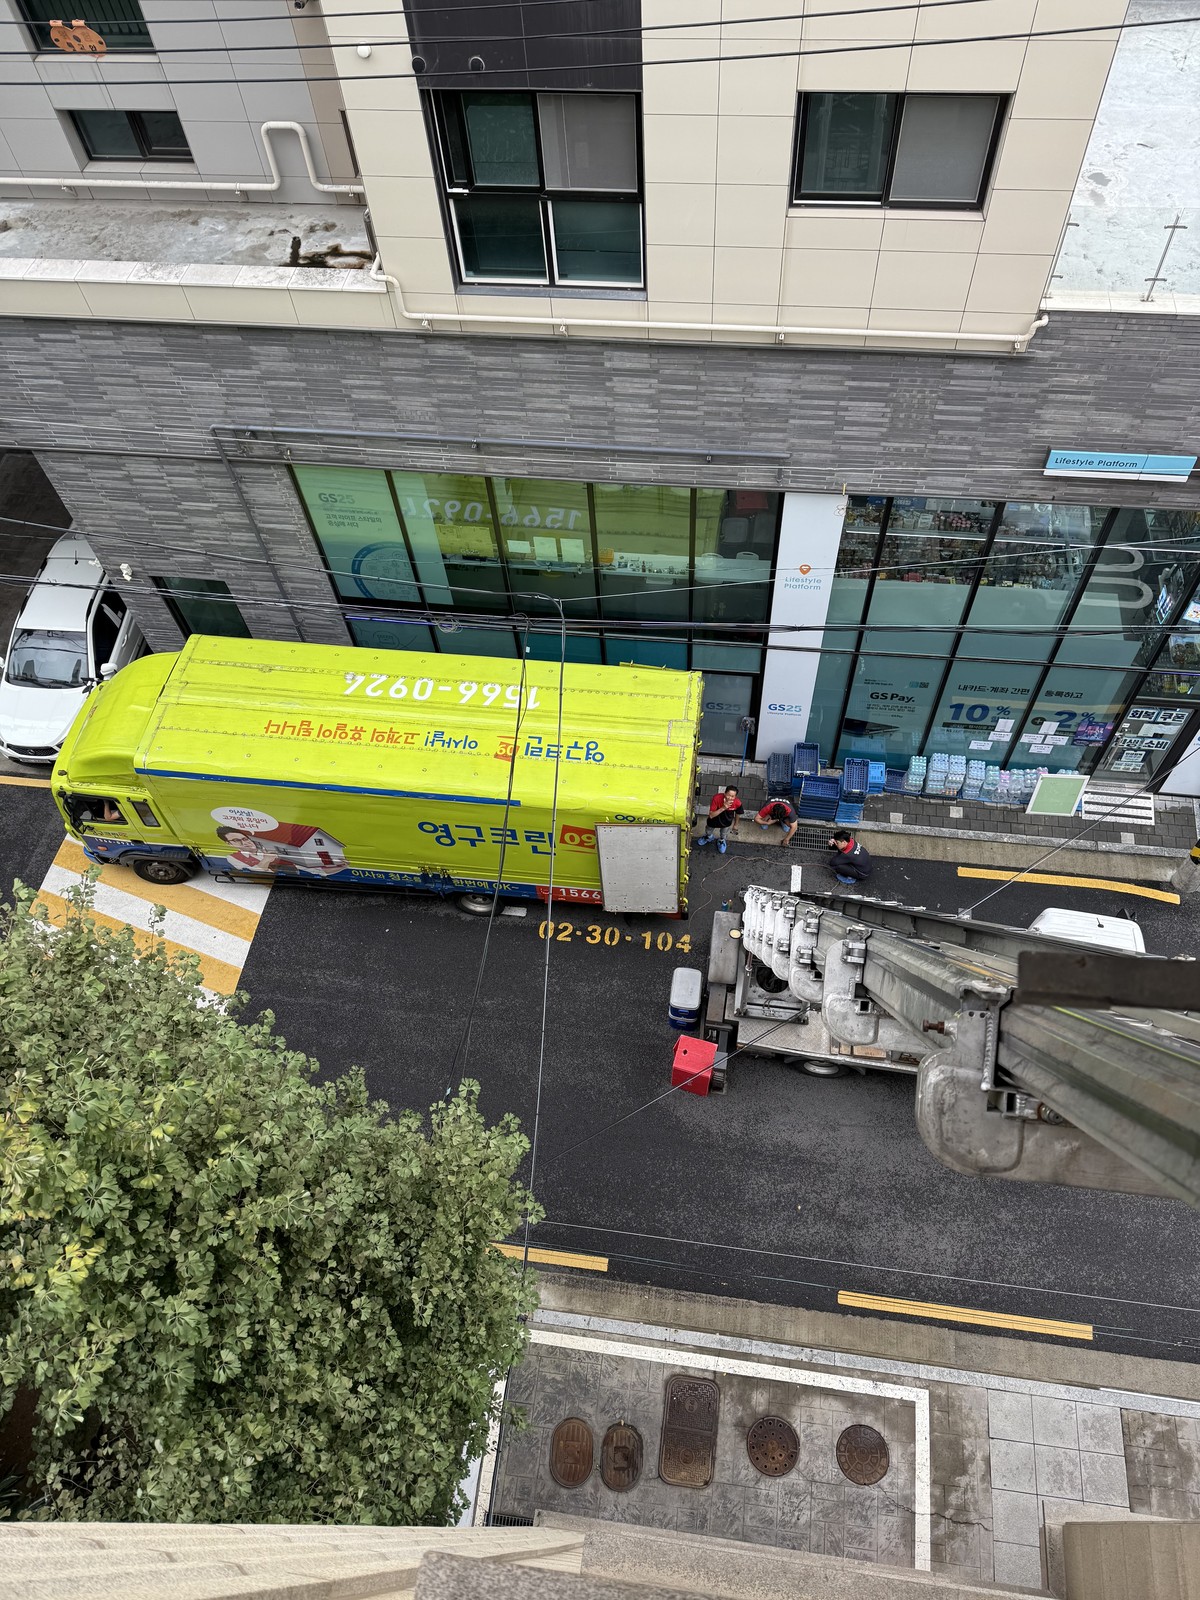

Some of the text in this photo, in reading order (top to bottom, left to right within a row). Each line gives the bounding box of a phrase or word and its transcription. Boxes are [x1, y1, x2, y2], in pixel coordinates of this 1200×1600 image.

[1055, 457, 1138, 468] Lifestyle Platform
[318, 492, 355, 504] GS25
[784, 576, 822, 585] Lifestyle
[783, 583, 821, 591] Platform
[344, 673, 541, 710] 1566-0924
[1010, 687, 1030, 695] 간편
[1044, 690, 1083, 699] 등록하고
[869, 692, 915, 704] GS Pay.
[705, 702, 741, 712] GS25
[767, 703, 802, 713] GS25
[1129, 709, 1186, 723] 회복 쿠폰
[264, 719, 314, 738] 됩니다
[317, 723, 367, 743] 휴일이
[370, 726, 420, 745] 고객의
[424, 730, 479, 751] 이사날!
[524, 735, 605, 763] 영구크린
[1143, 740, 1168, 750] 소비
[417, 821, 557, 856] 영구크린
[351, 869, 385, 879] 이사와
[452, 879, 489, 890] 한번에
[559, 887, 601, 899] 1566
